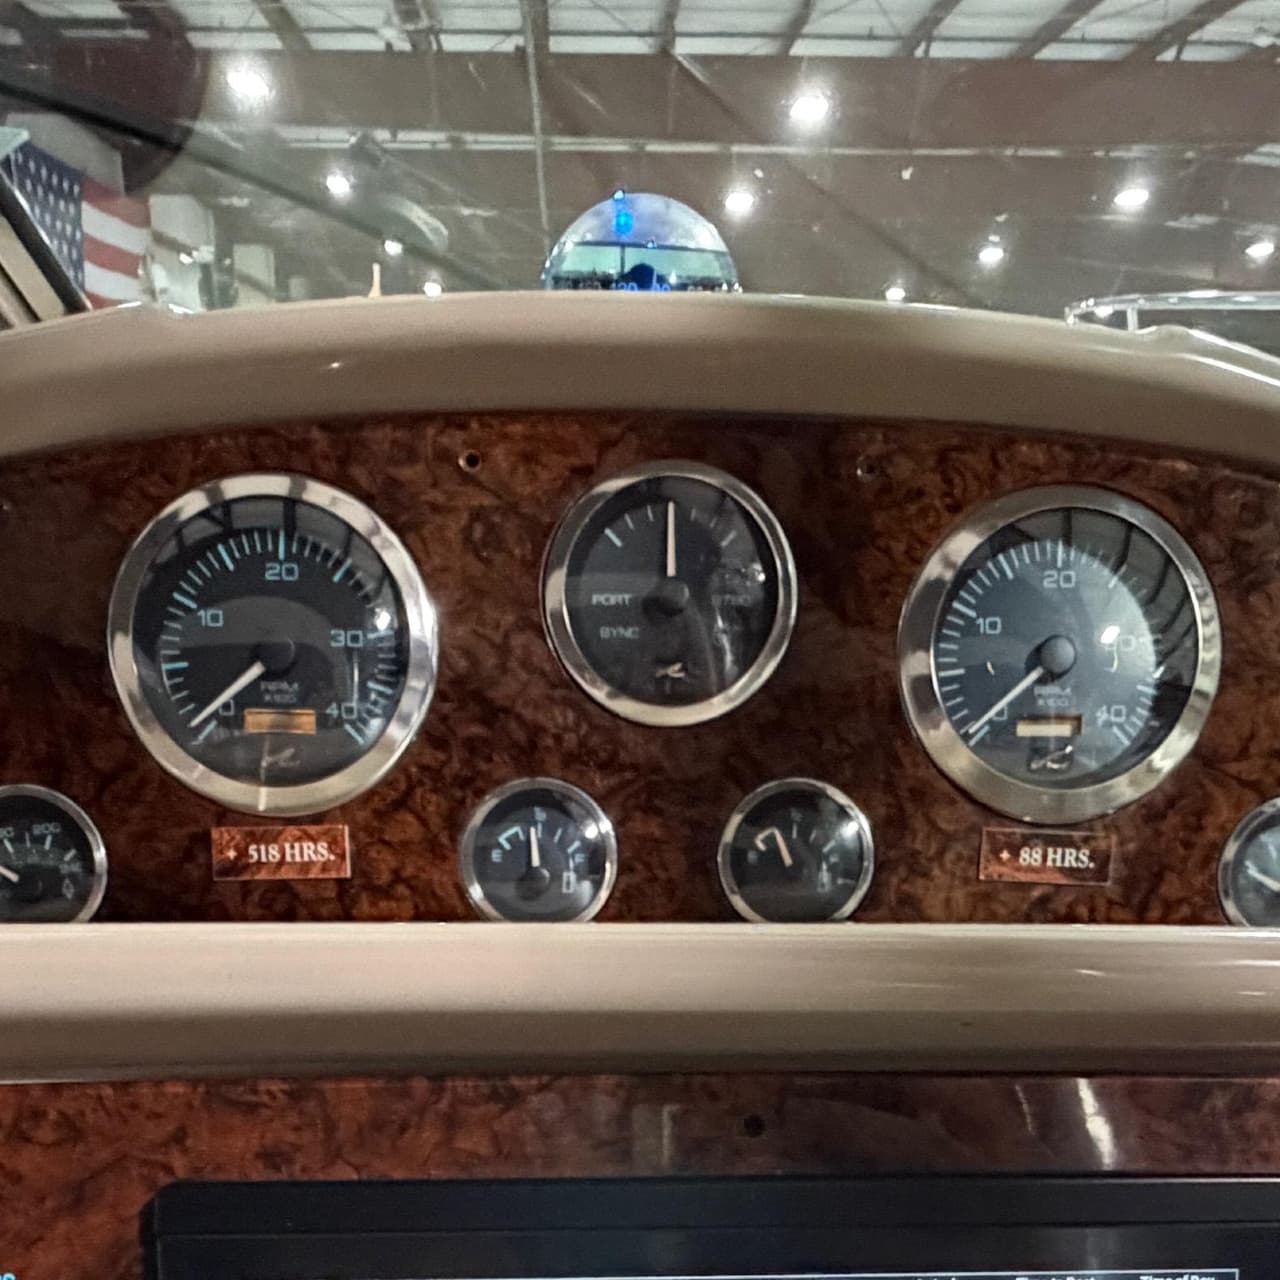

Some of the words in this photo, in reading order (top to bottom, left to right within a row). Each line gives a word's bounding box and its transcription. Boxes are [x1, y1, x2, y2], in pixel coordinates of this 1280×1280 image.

[265, 564, 298, 580] 20
[1042, 571, 1076, 588] 20
[197, 611, 223, 627] 10
[975, 617, 1002, 633] 10
[330, 629, 363, 647] 30
[326, 702, 357, 719] 40
[1096, 705, 1126, 722] 40
[247, 846, 280, 862] 518
[283, 843, 335, 861] HRS.
[1019, 847, 1042, 866] 88
[1046, 848, 1095, 869] HRS.
